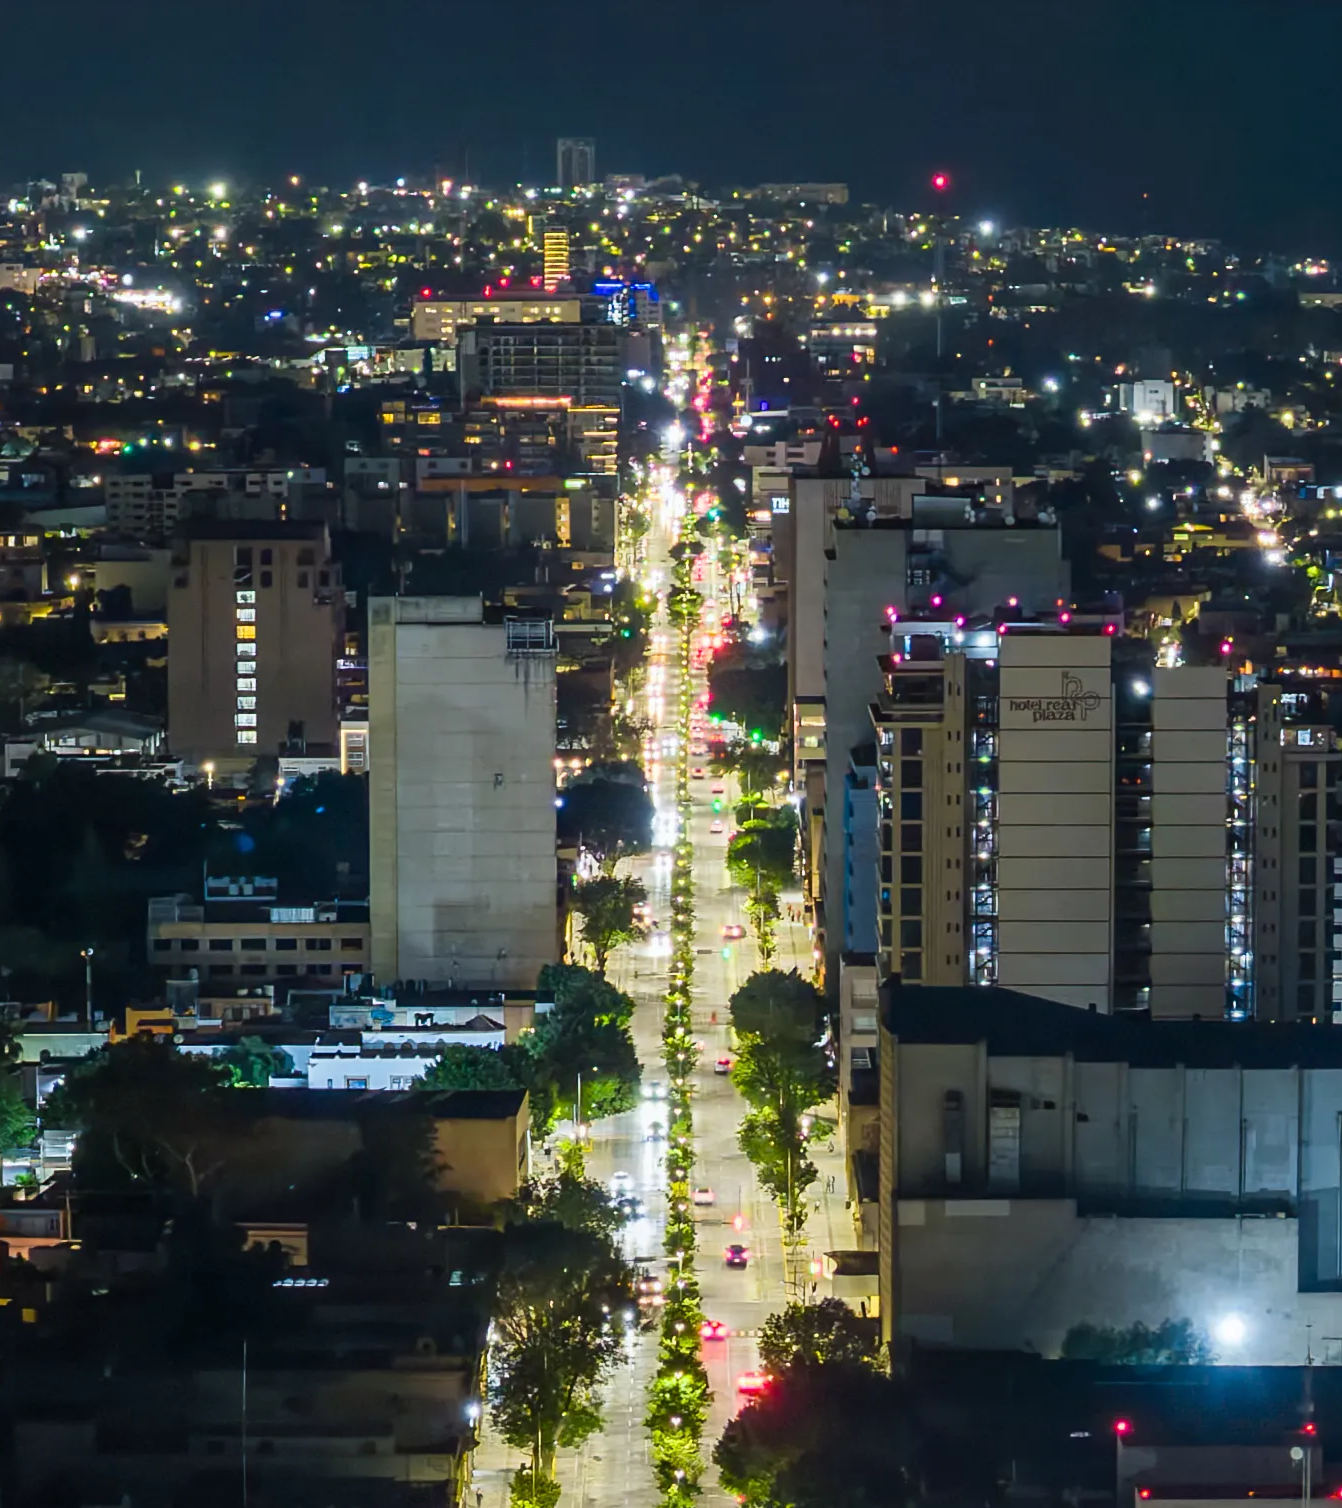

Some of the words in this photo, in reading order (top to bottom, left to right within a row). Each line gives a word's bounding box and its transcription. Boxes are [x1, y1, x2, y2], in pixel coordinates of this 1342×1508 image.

[1009, 699, 1042, 711] hotel
[1046, 699, 1077, 711] real
[1032, 709, 1076, 723] plaza
